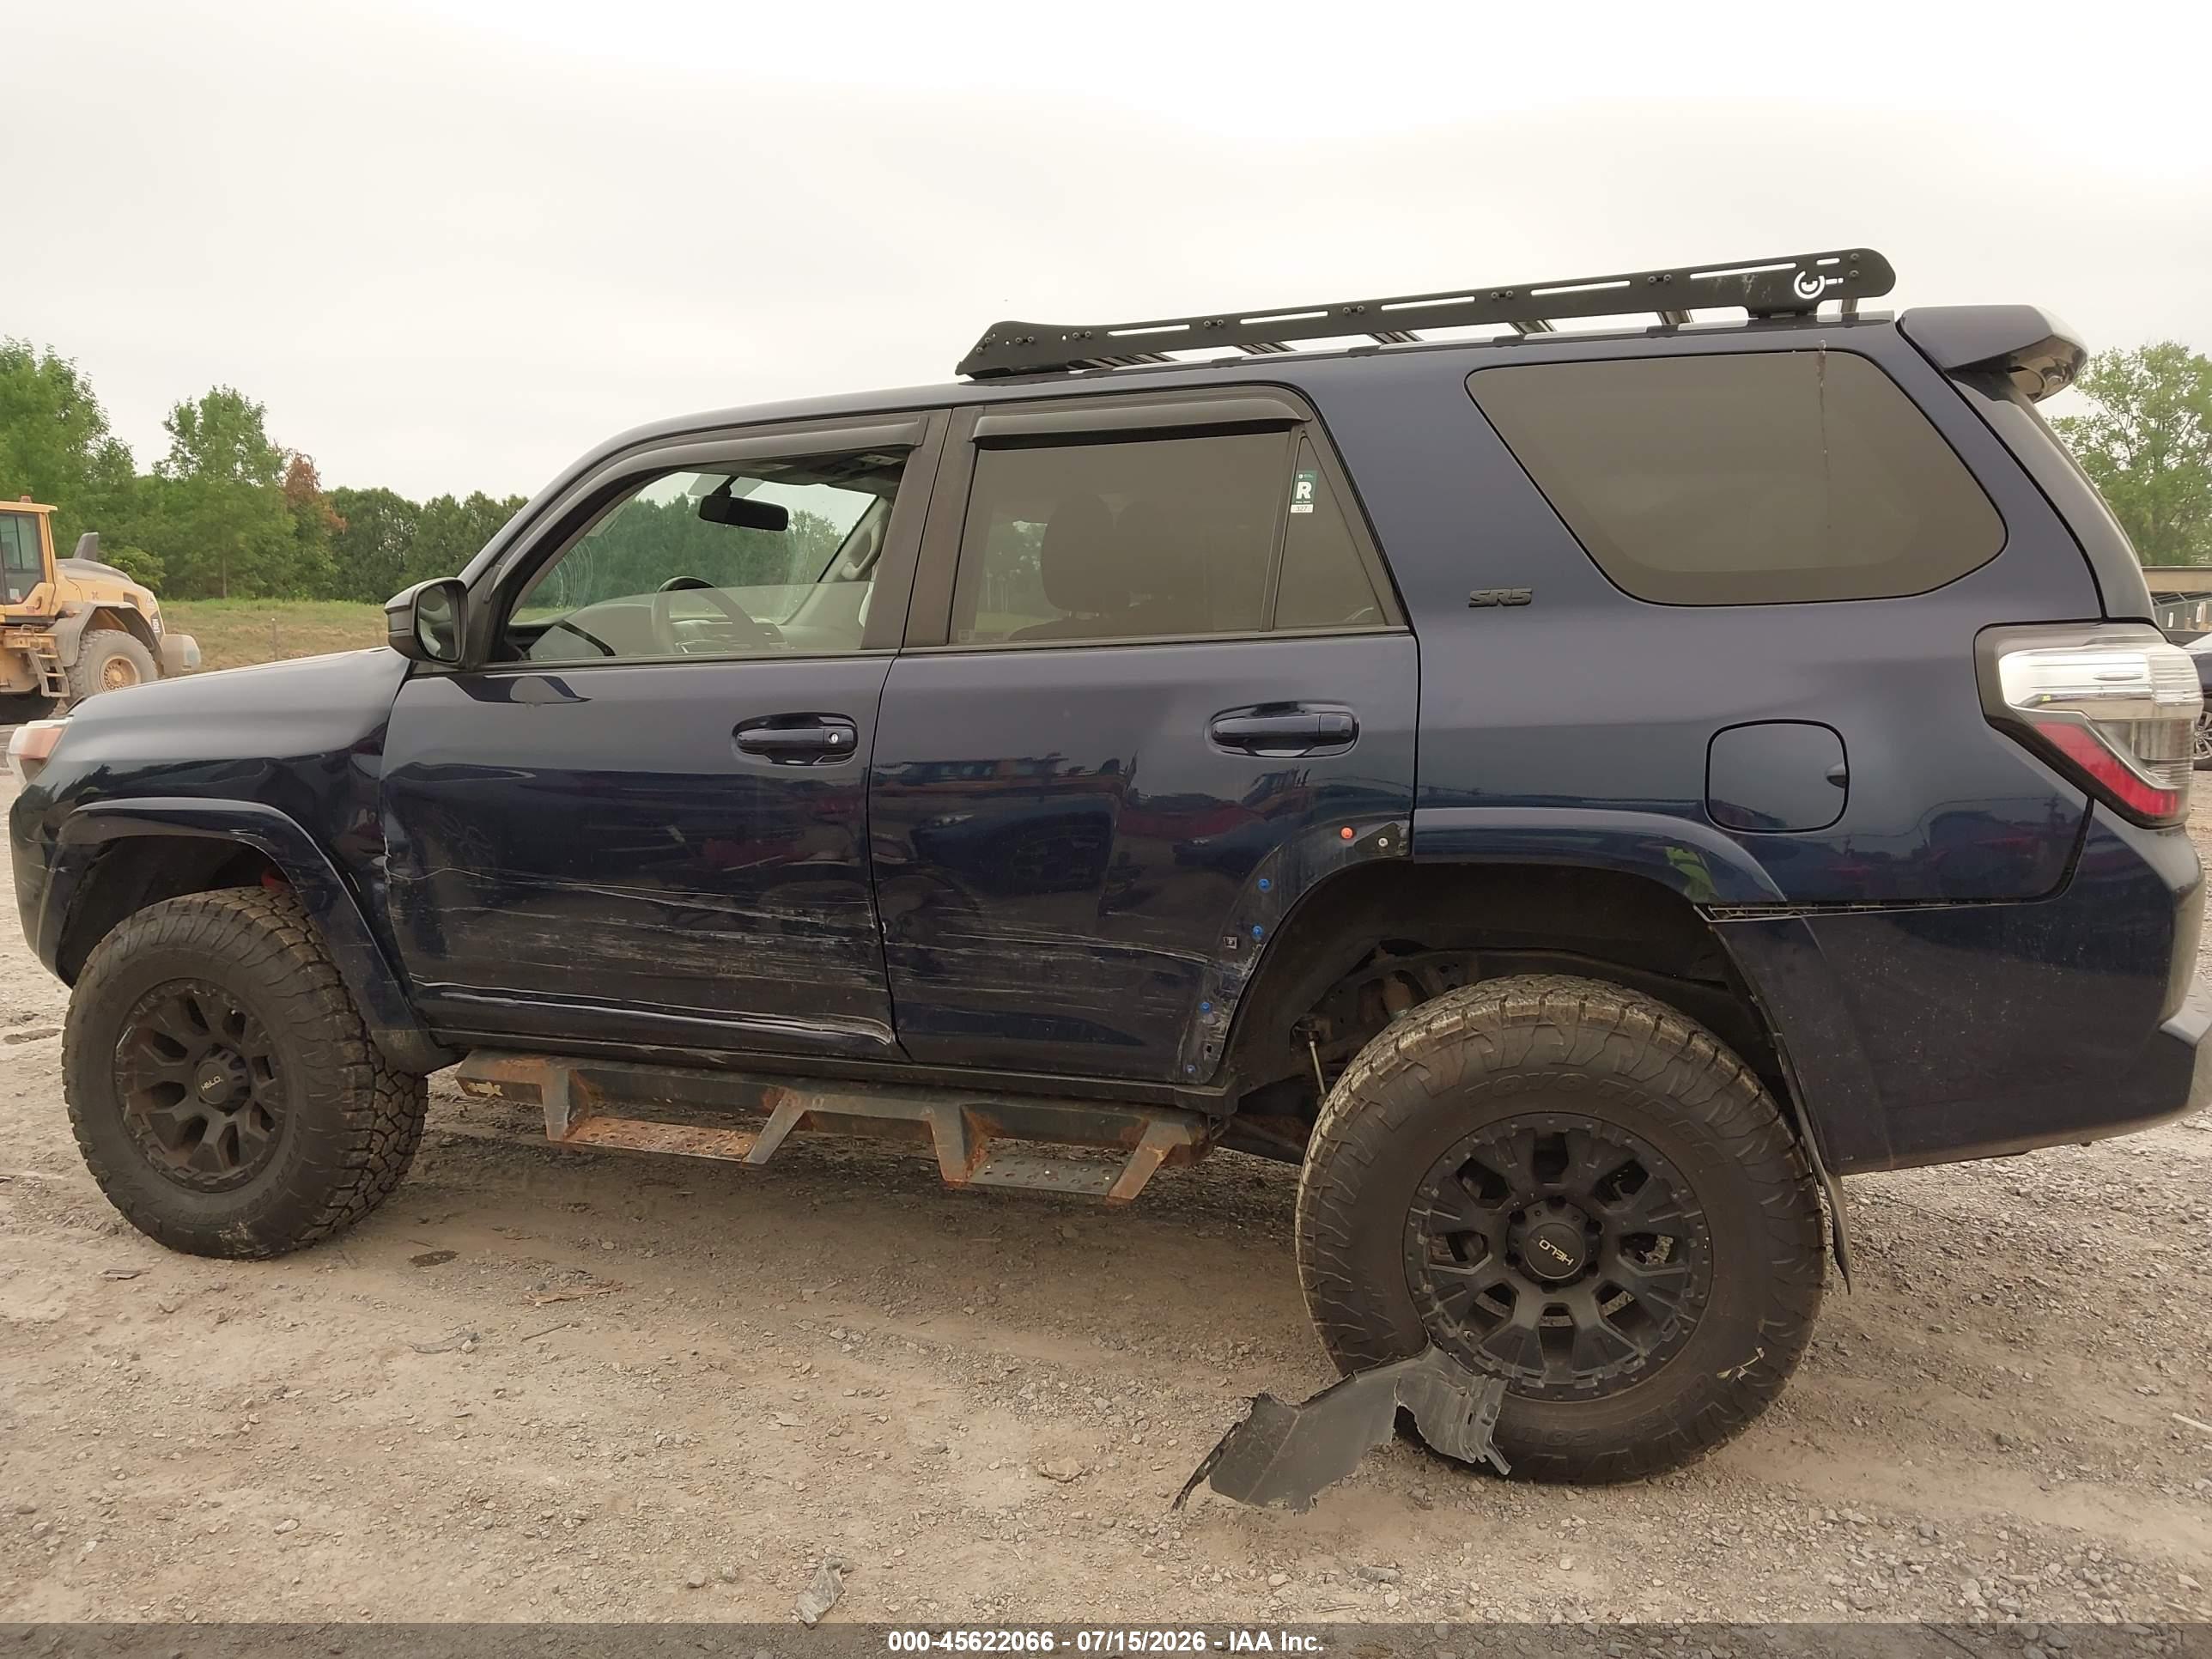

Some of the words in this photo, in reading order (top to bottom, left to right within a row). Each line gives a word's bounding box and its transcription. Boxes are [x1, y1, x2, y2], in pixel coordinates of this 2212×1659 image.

[1296, 481, 1312, 500] R
[1468, 588, 1533, 607] SR5
[200, 1075, 222, 1091] HELO
[1463, 1071, 1590, 1108] TOYO
[1538, 1238, 1575, 1267] HELO
